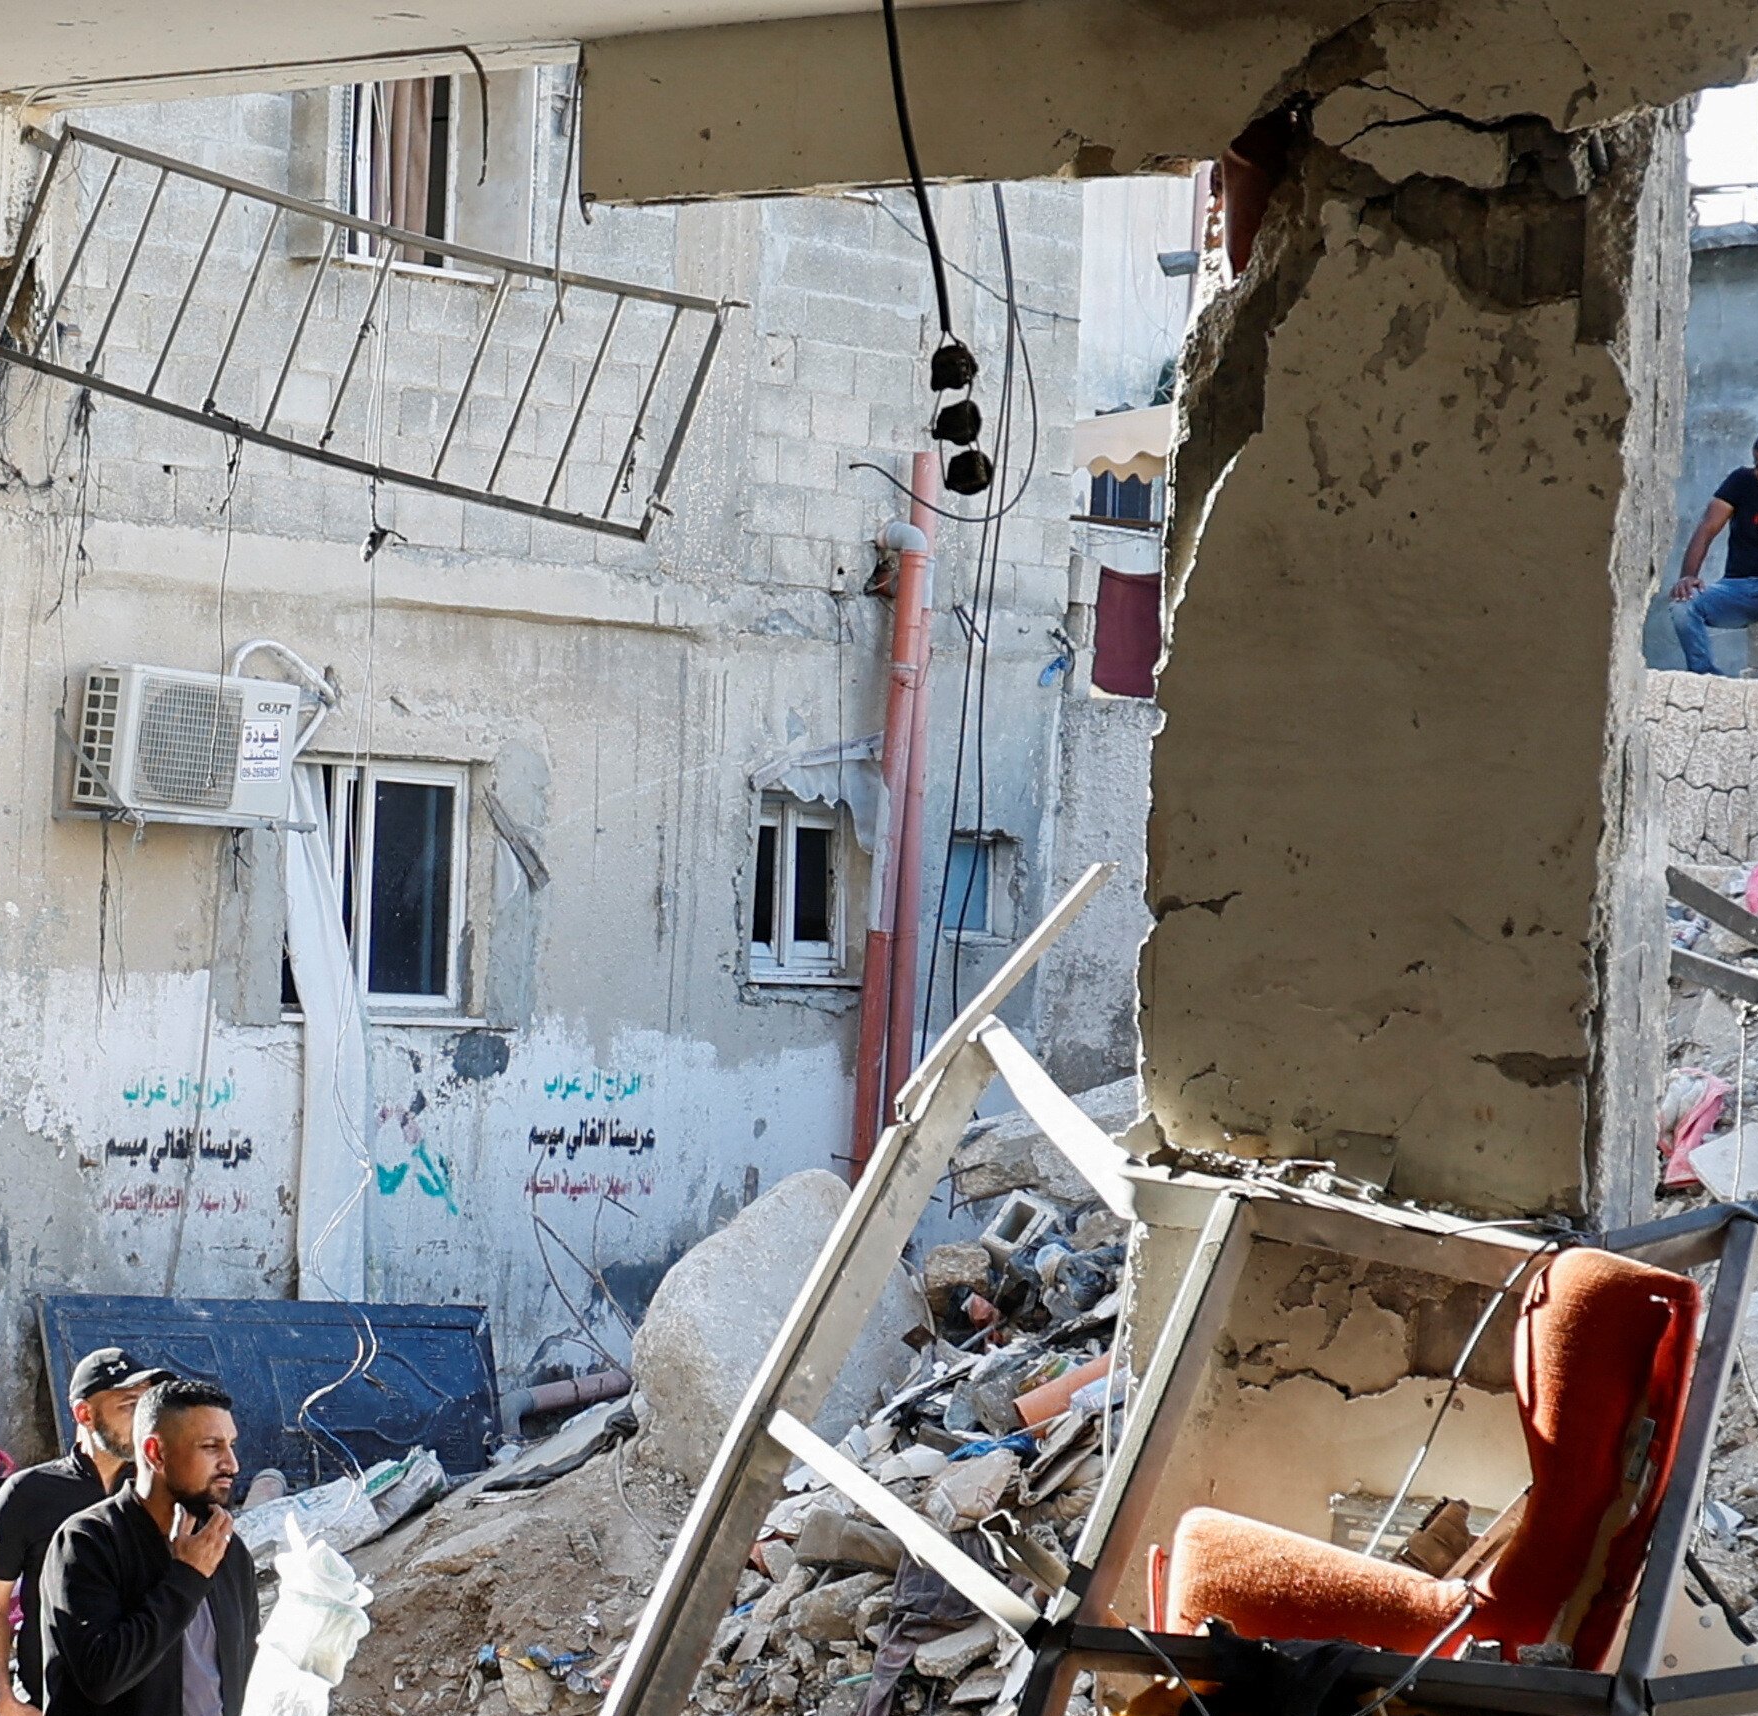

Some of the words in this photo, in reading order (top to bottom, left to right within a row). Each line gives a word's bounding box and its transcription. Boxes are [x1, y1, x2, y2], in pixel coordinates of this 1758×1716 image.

[257, 702, 292, 716] CRAFT
[244, 723, 279, 748] فودة
[123, 1075, 168, 1109] غراب
[566, 1117, 606, 1160] الغالي
[609, 1117, 656, 1156] عريسنا
